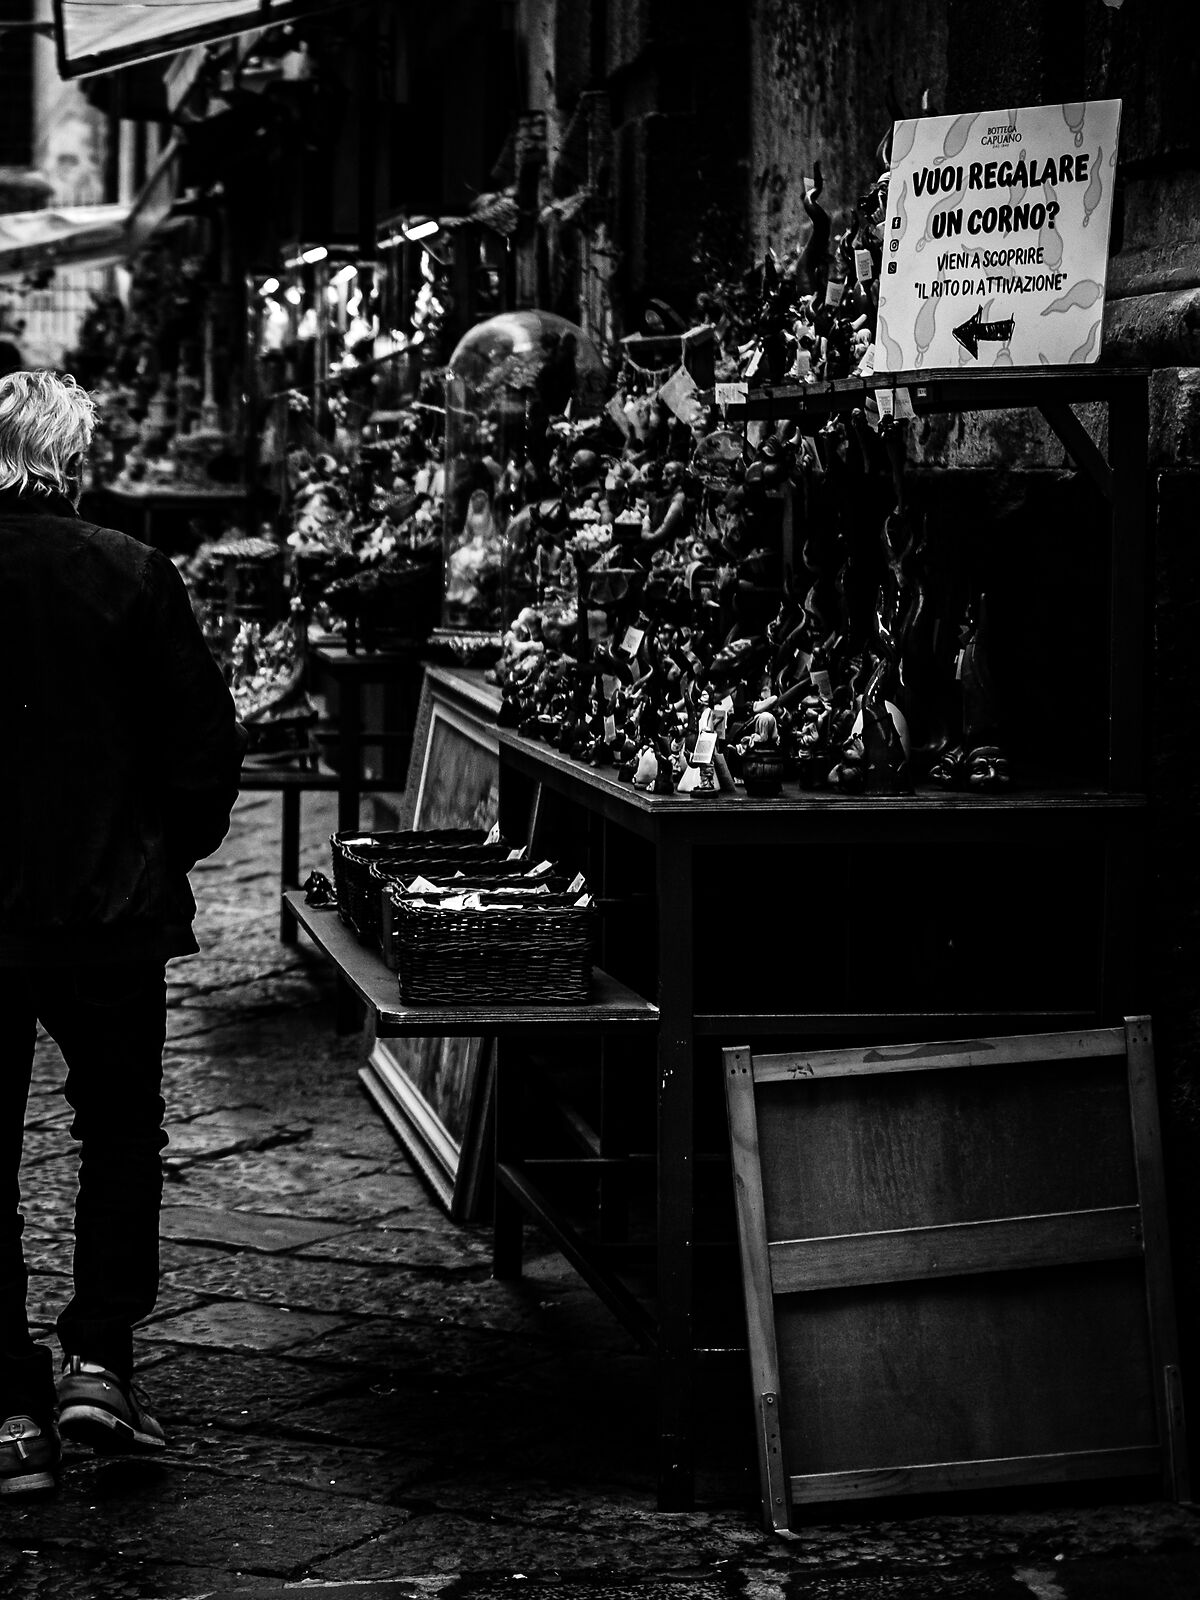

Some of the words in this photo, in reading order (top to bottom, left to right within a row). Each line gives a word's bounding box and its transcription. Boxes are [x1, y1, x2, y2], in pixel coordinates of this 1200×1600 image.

[981, 133, 1022, 145] CAPUANO
[987, 125, 1017, 135] BOTTEGA
[913, 166, 964, 197] VUOI
[968, 154, 1090, 190] REGALARE
[932, 209, 964, 239] UN
[967, 201, 1061, 235] CORNO?
[937, 252, 970, 271] VIENI
[971, 252, 981, 269] A
[983, 246, 1045, 268] SCOPRIRE
[914, 282, 929, 300] "IL
[931, 279, 960, 298] RITO
[962, 279, 974, 296] DI
[976, 273, 1068, 296] ATTIVAZIONE"
